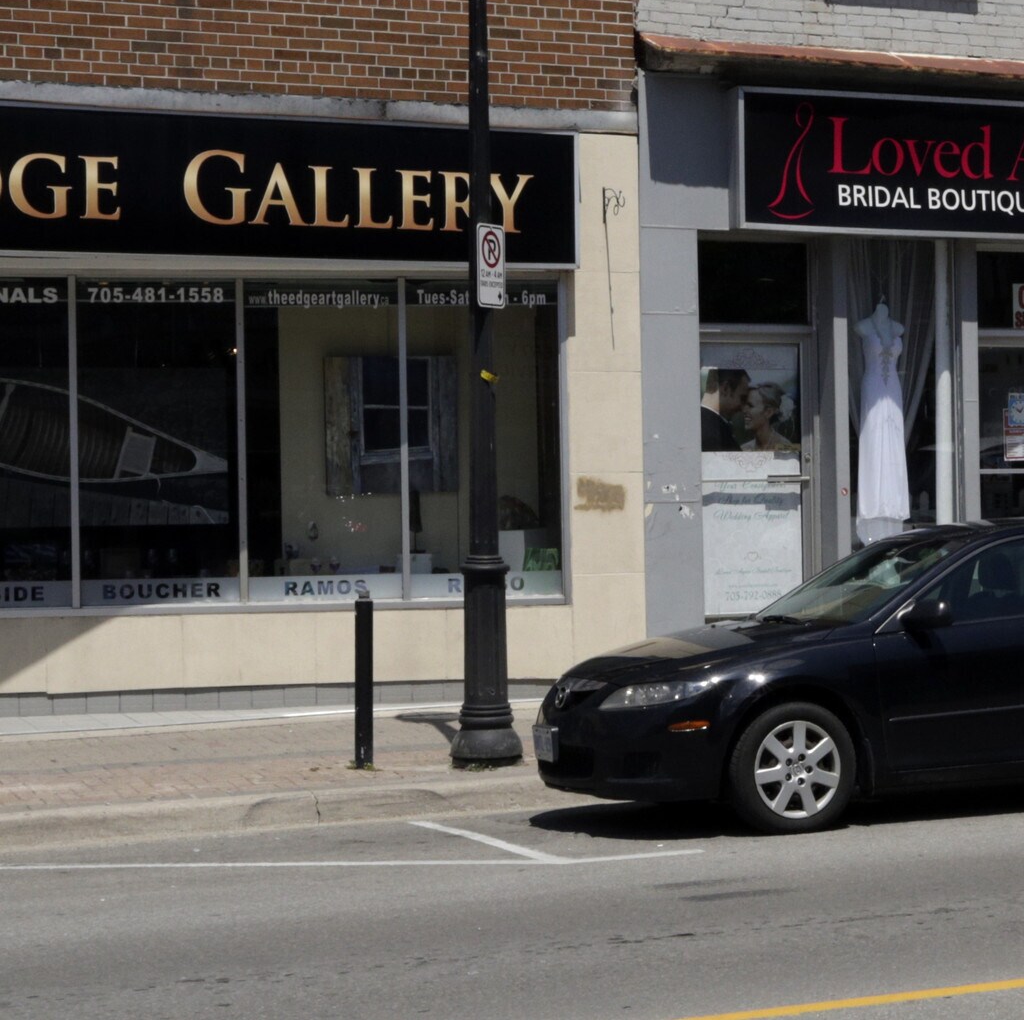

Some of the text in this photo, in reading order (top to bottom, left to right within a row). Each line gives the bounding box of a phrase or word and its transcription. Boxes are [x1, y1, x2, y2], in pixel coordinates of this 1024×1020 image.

[827, 116, 994, 180] Loved
[0, 149, 536, 234] GE GALLERY
[838, 184, 921, 209] BRIDAL
[87, 287, 224, 304] 705-481-1558
[248, 288, 390, 309] www.theedgeartgallery.ca
[416, 288, 470, 306] Tues-Sat
[521, 288, 546, 309] 6pm
[0, 586, 45, 602] IDE
[103, 582, 221, 600] BOUCHER
[284, 579, 368, 596] RAMOS
